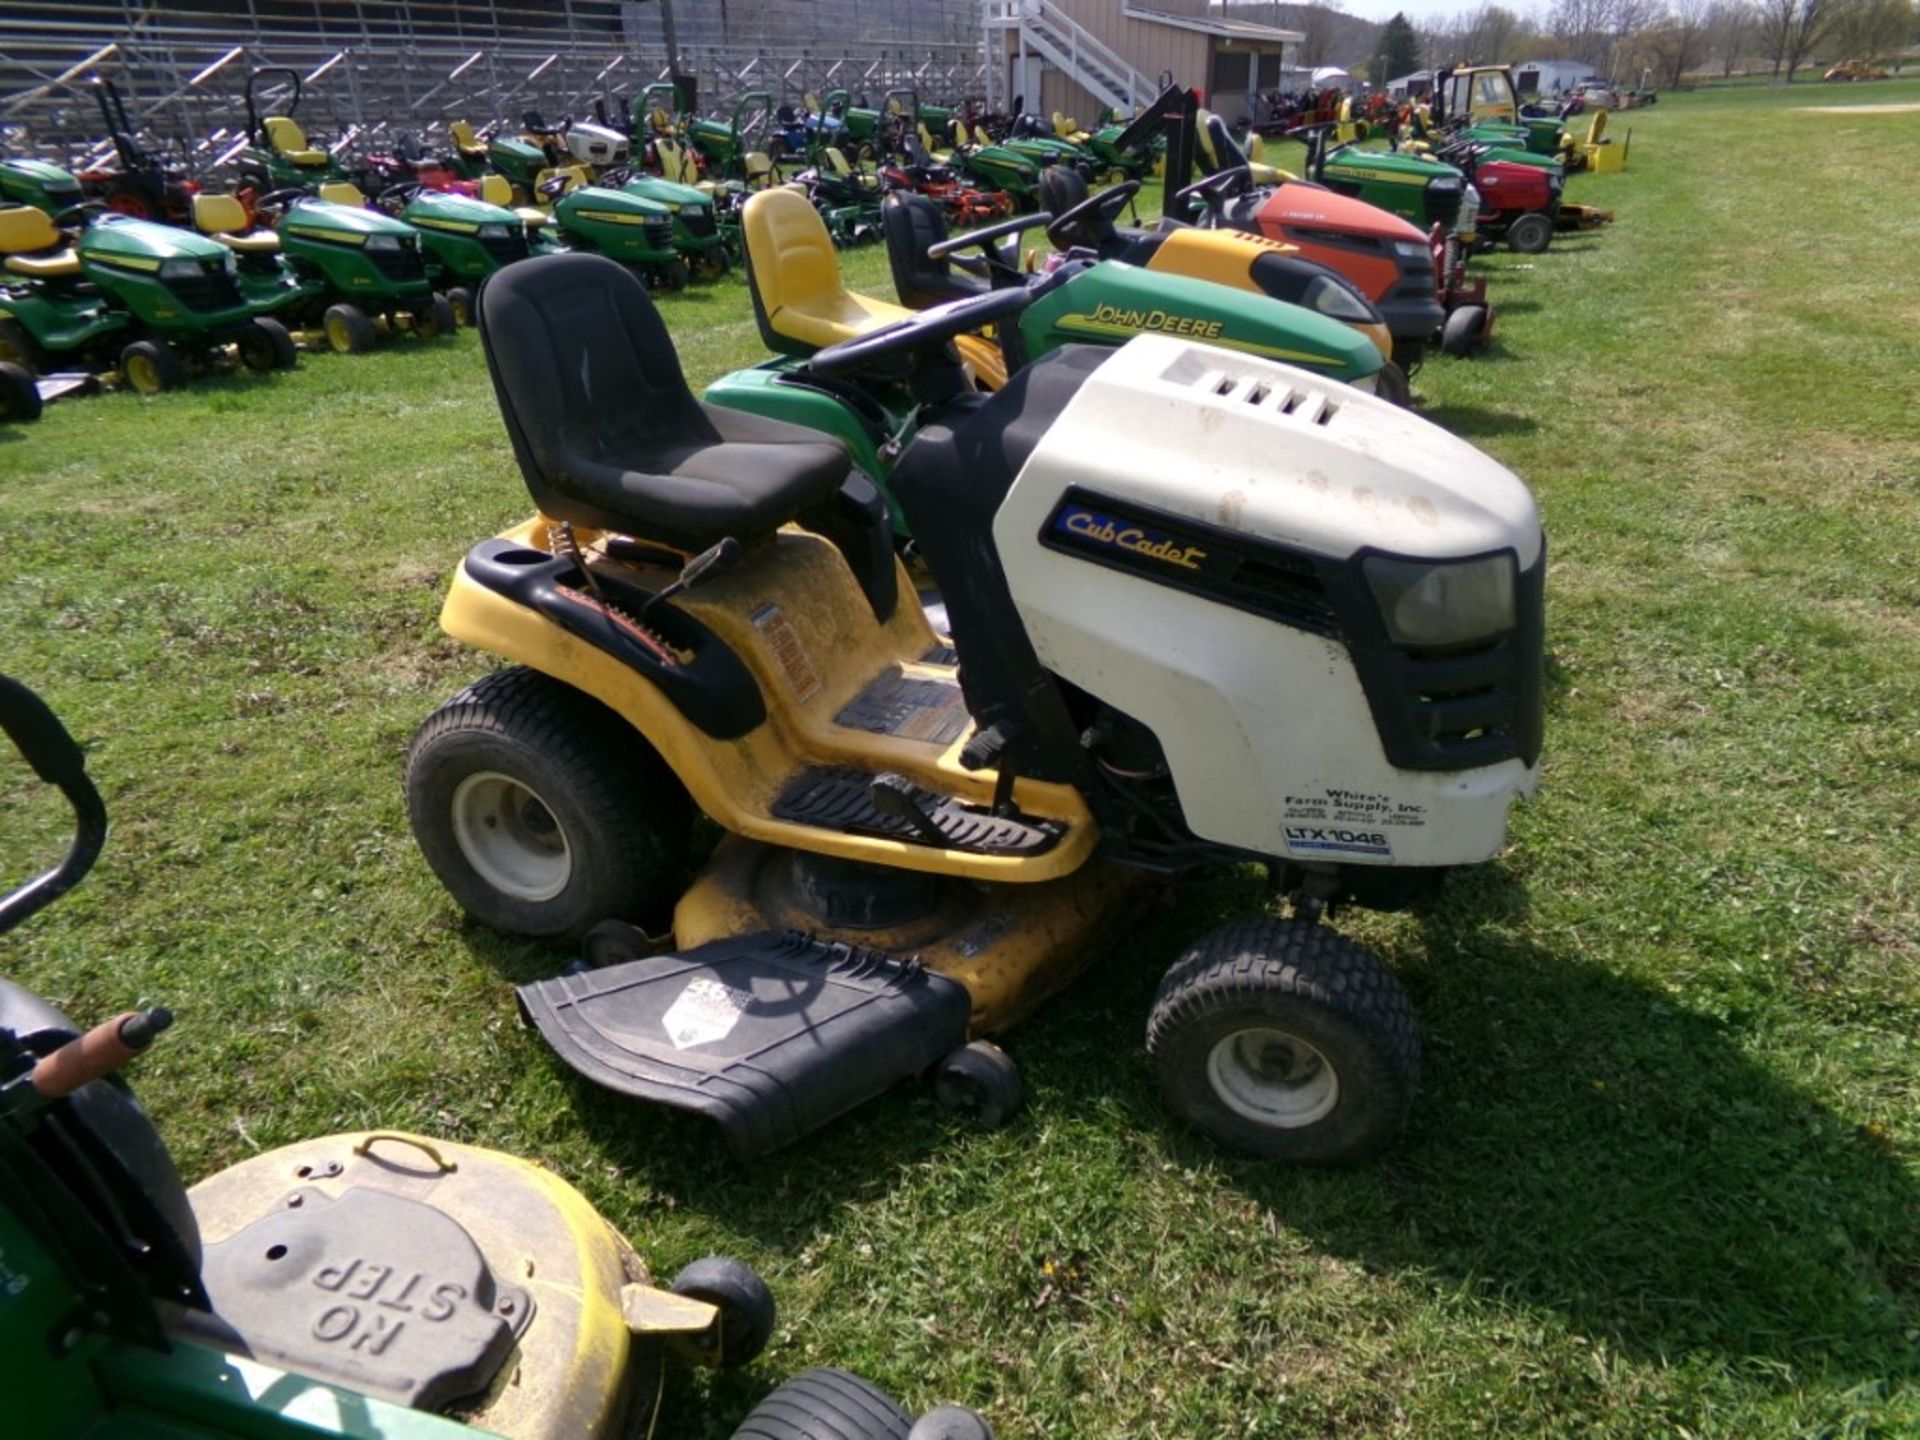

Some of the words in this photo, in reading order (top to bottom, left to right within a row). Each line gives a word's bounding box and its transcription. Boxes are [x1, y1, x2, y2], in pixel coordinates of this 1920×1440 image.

[1085, 303, 1146, 328] JOHN
[1147, 310, 1223, 338] DEERE
[1285, 795, 1328, 807] Farm
[1397, 803, 1428, 814] Inc.
[1326, 788, 1391, 802] White's
[312, 1257, 468, 1323] STEP
[312, 1304, 404, 1357] NO
